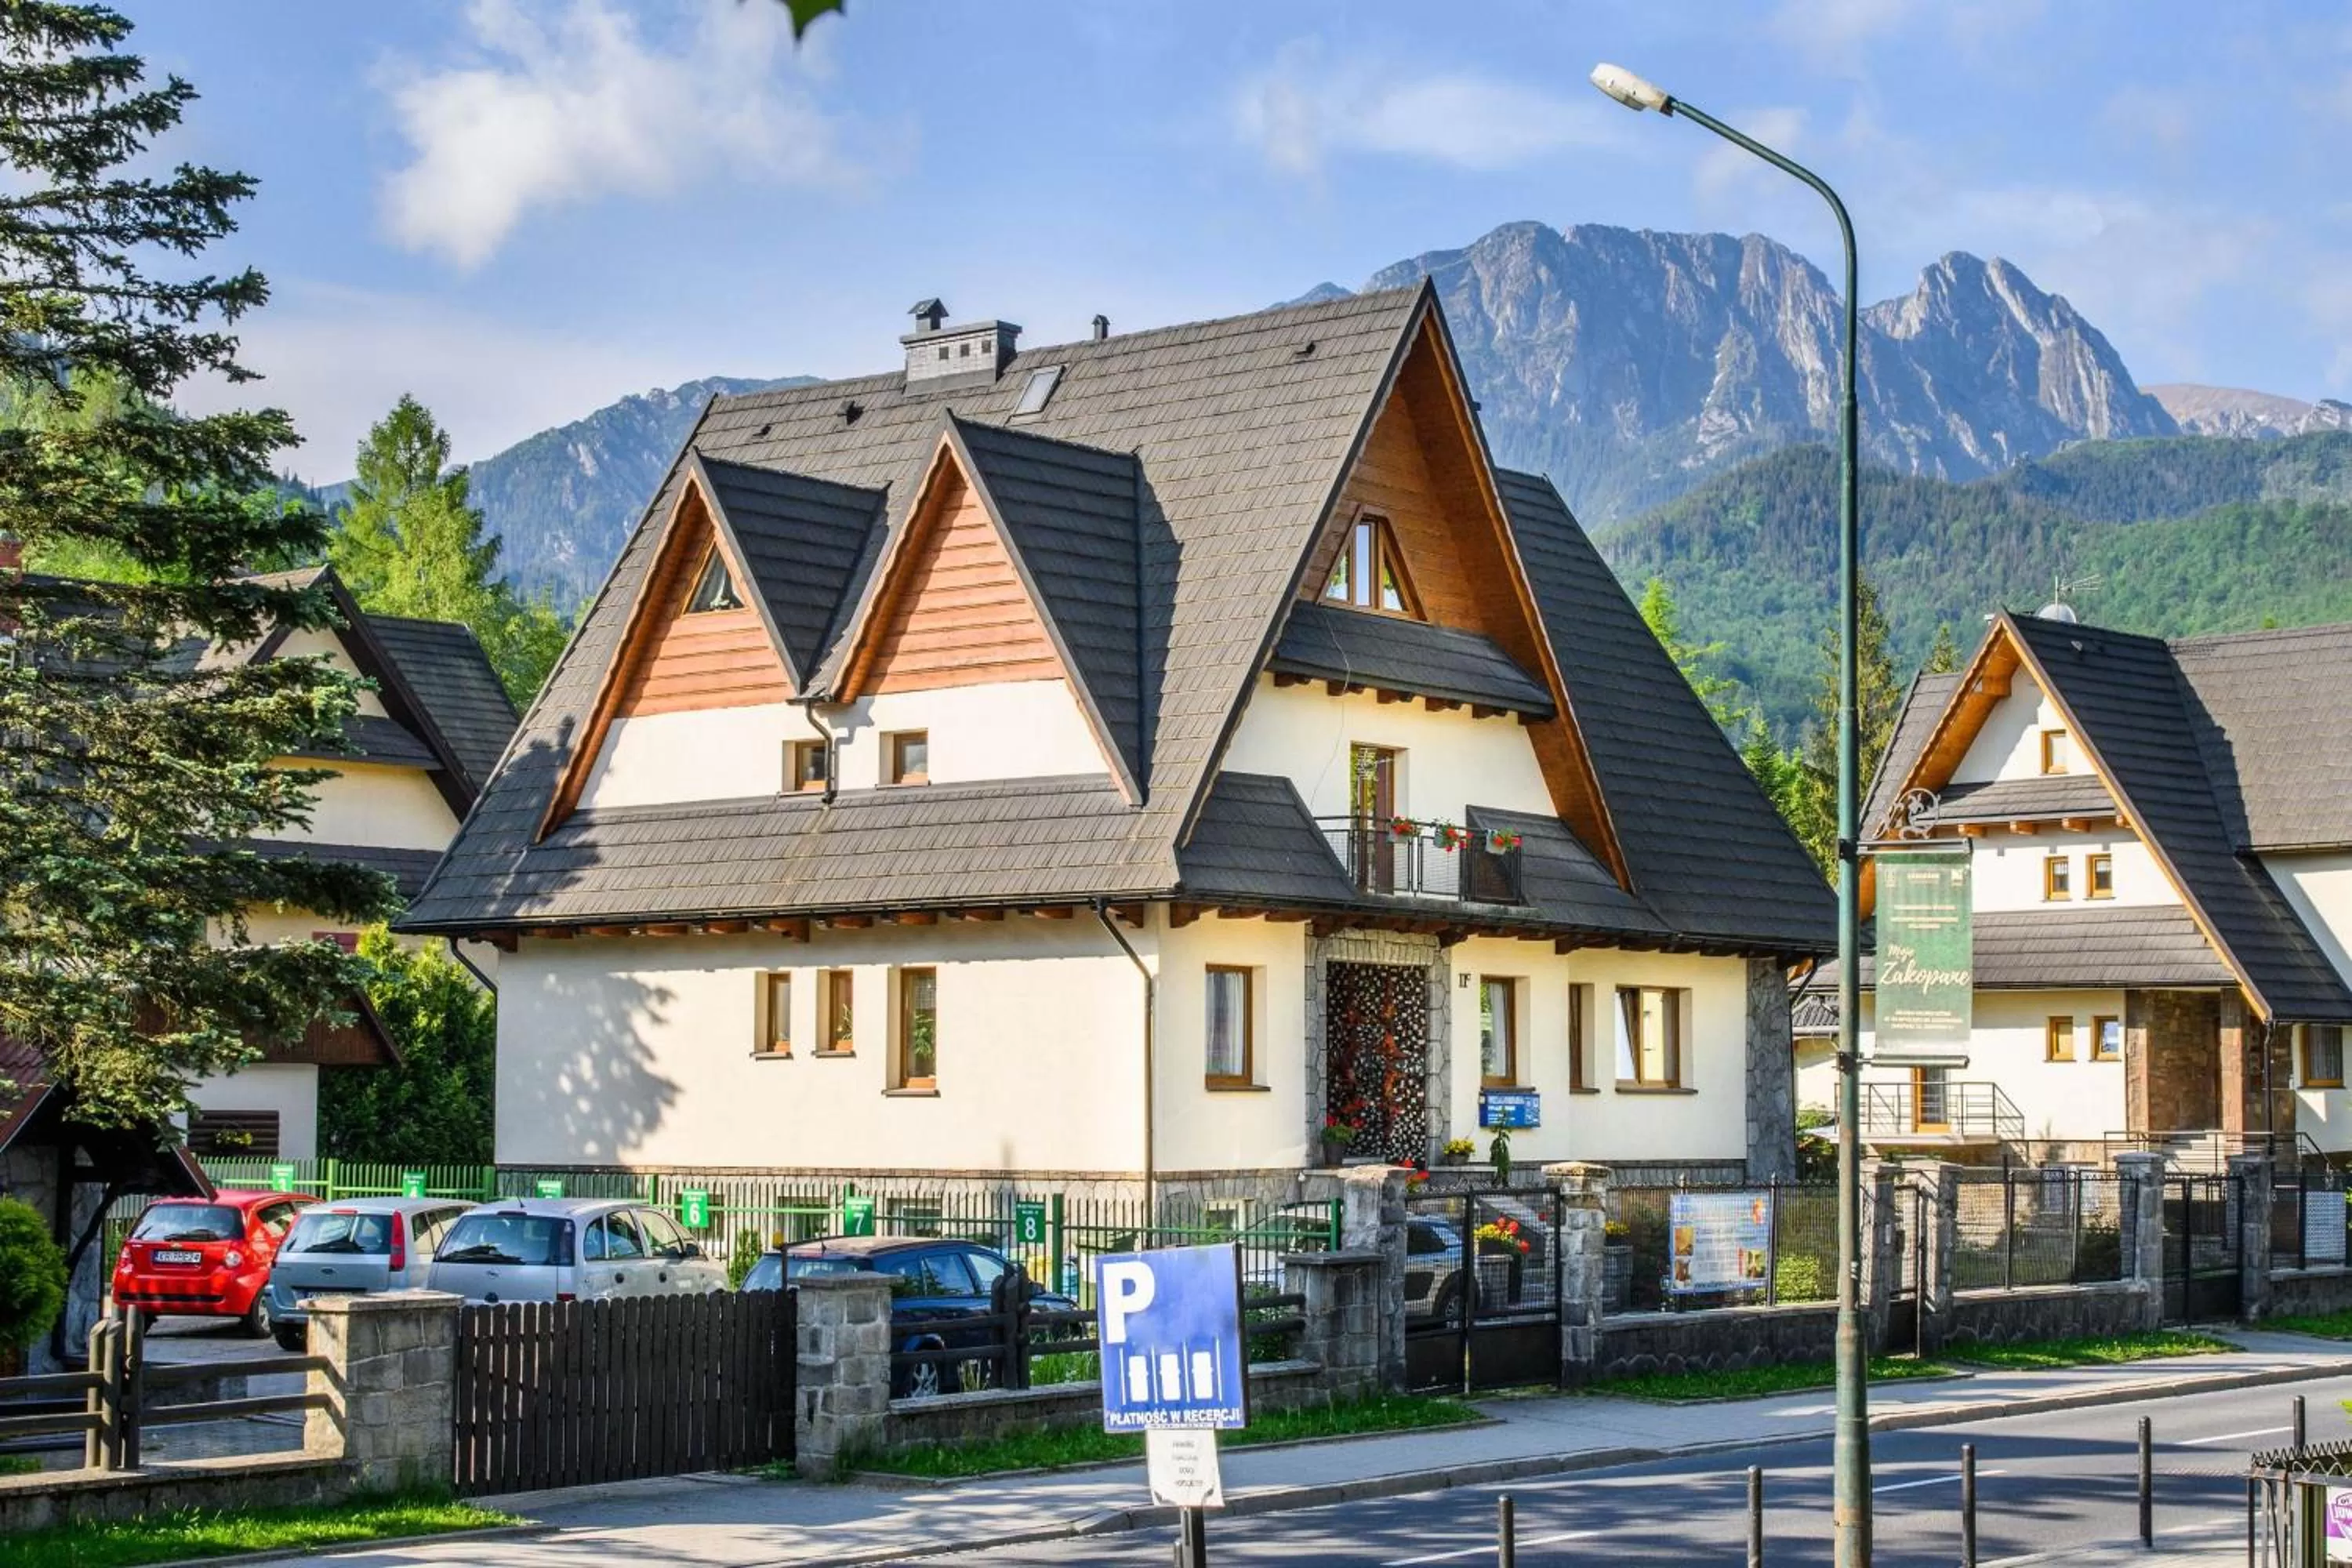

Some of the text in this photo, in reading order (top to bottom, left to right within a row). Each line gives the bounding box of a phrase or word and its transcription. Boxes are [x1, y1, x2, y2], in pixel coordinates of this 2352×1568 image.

[1880, 959, 1970, 995] Zakopane
[690, 1203, 700, 1225] 6
[853, 1213, 865, 1234] 7
[1025, 1217, 1036, 1240] 8
[1103, 1261, 1155, 1344] P
[1110, 1408, 1240, 1425] PŁATNOŚĆ W RECEPCJI
